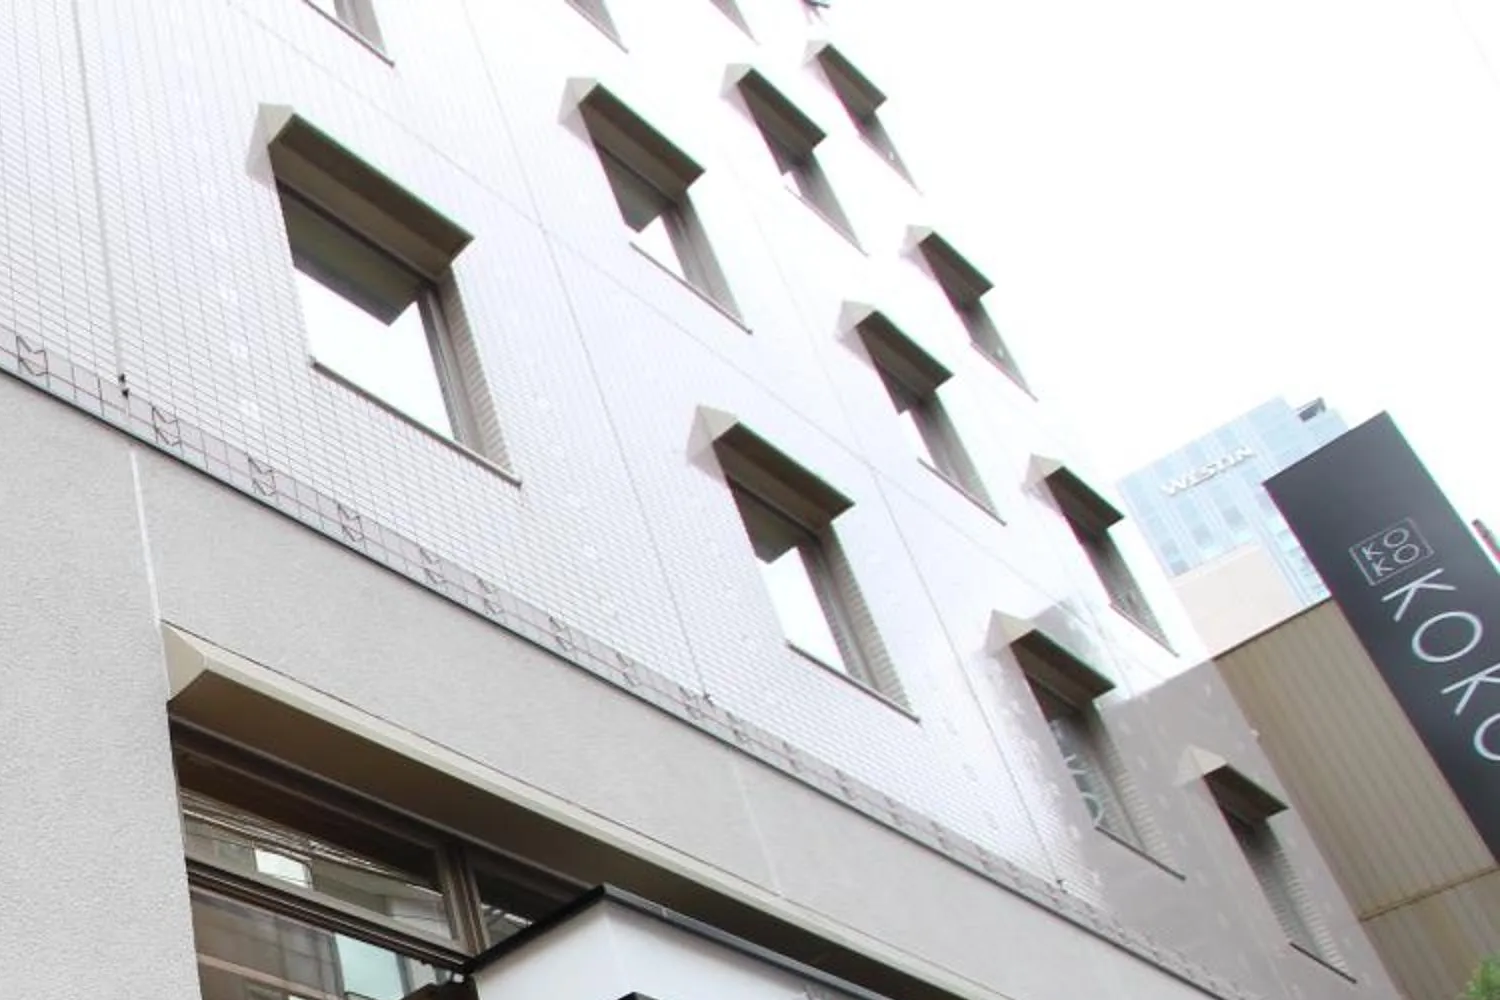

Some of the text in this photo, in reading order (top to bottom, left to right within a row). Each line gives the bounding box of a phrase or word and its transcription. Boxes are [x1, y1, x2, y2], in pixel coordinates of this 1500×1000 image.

[1161, 445, 1255, 496] WESTIN
[1362, 527, 1409, 562] KO
[1372, 543, 1420, 577] KO
